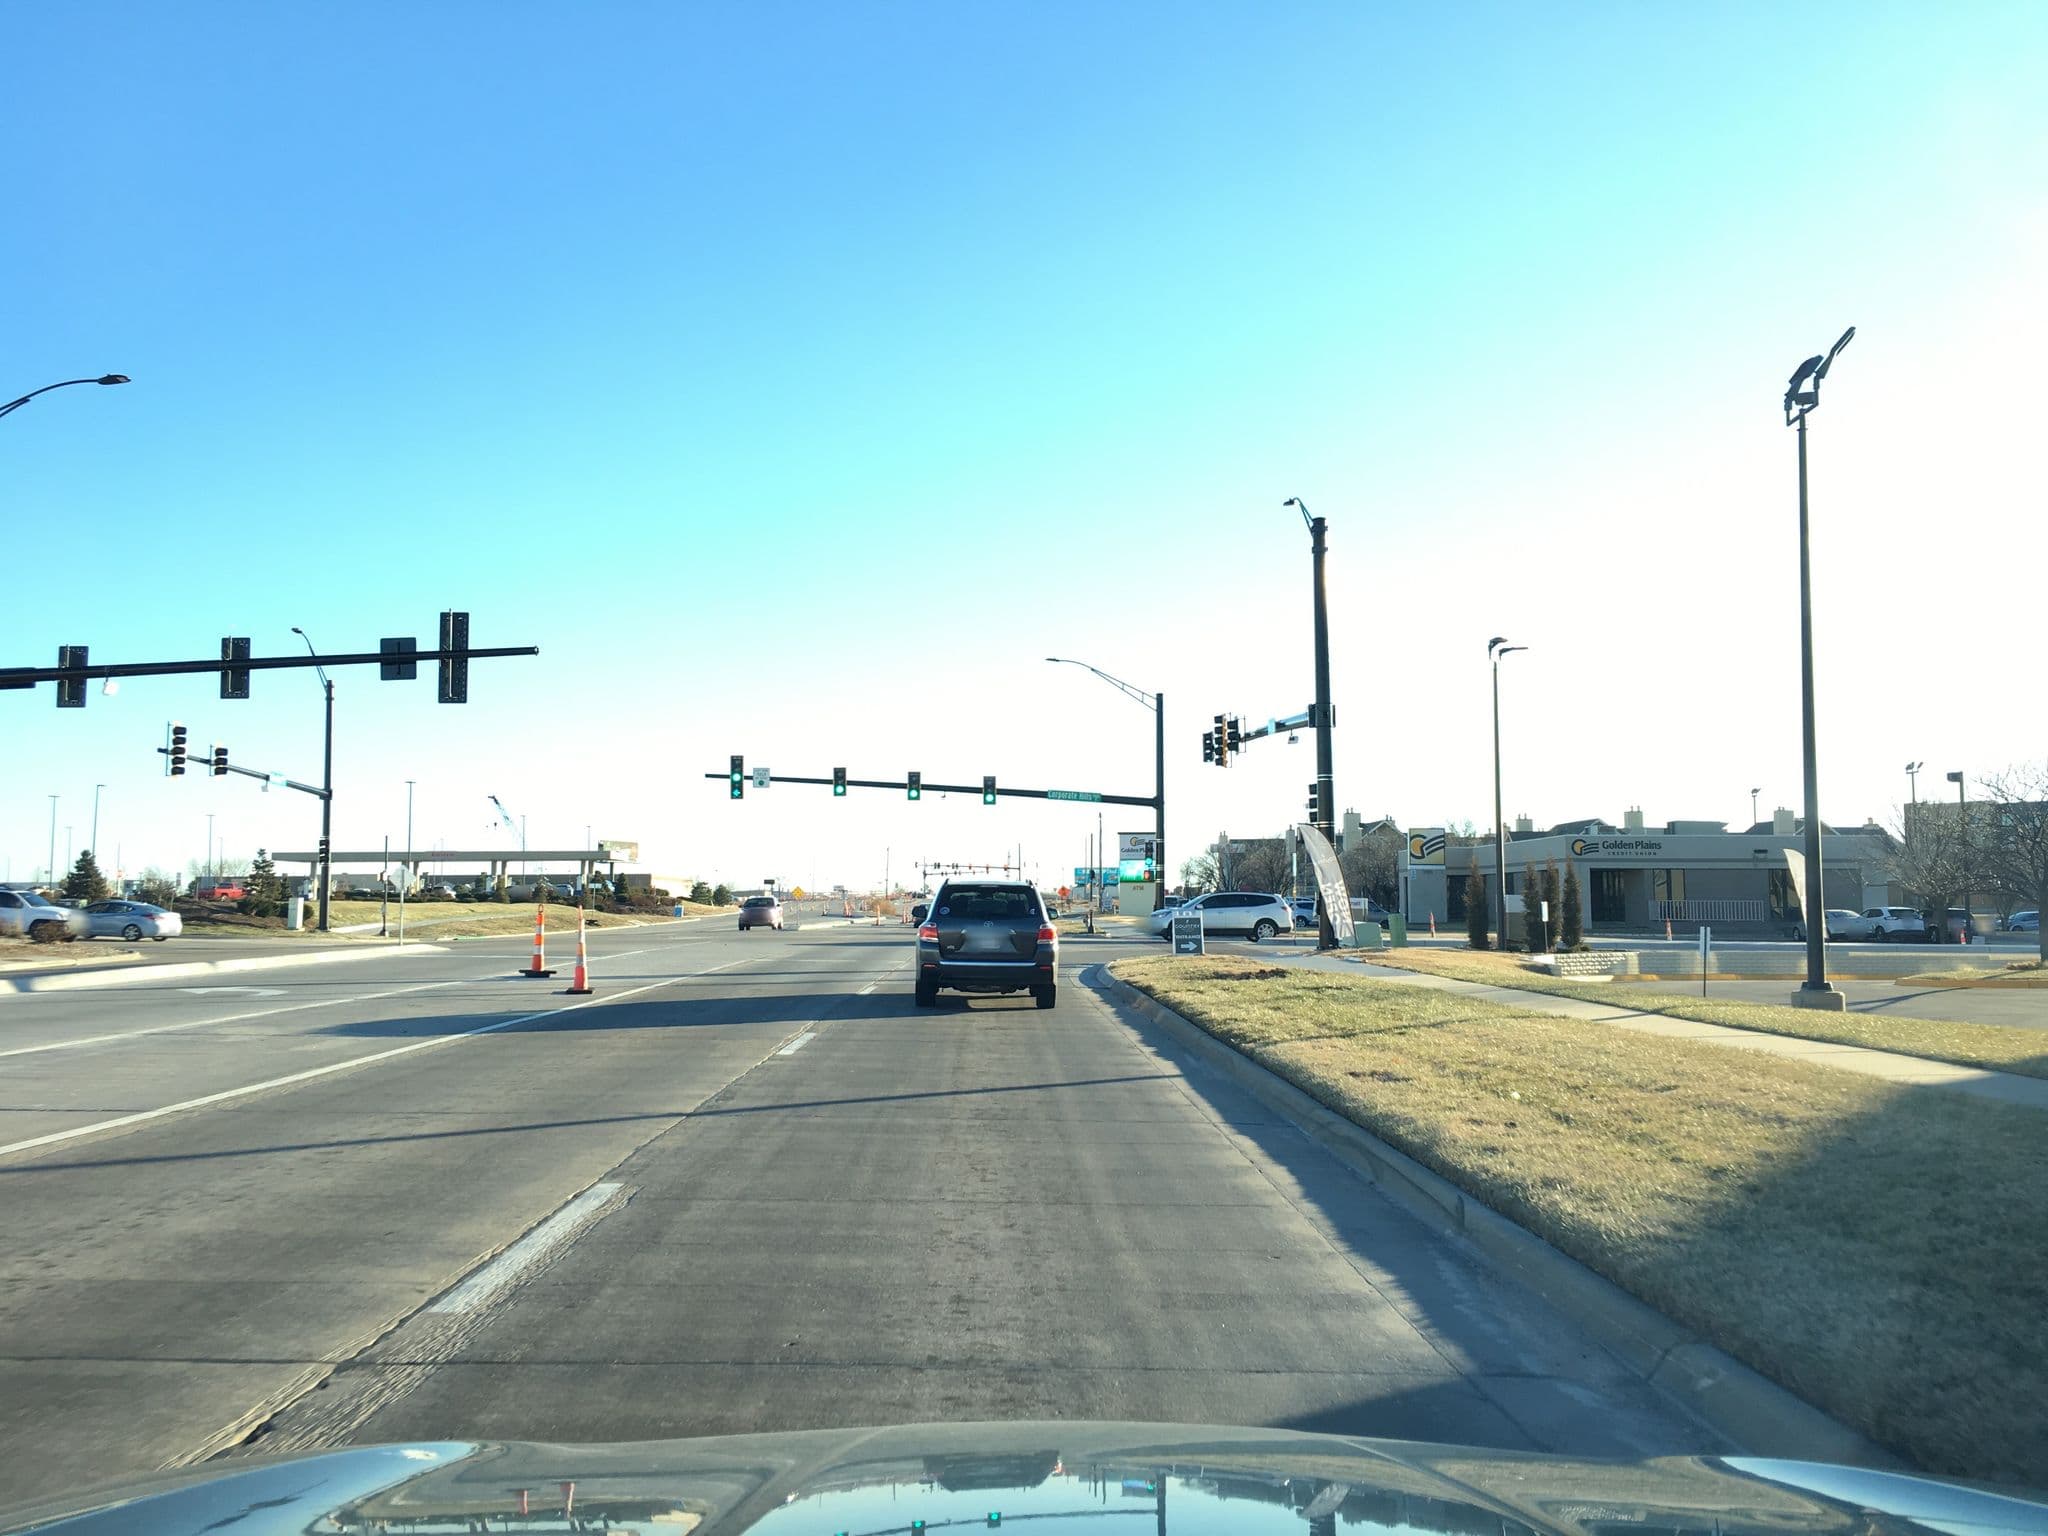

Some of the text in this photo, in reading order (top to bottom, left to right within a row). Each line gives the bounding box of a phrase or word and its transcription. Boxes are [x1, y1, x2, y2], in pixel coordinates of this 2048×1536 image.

[1048, 790, 1078, 800] Corporate
[1602, 840, 1662, 849] Golden Plains
